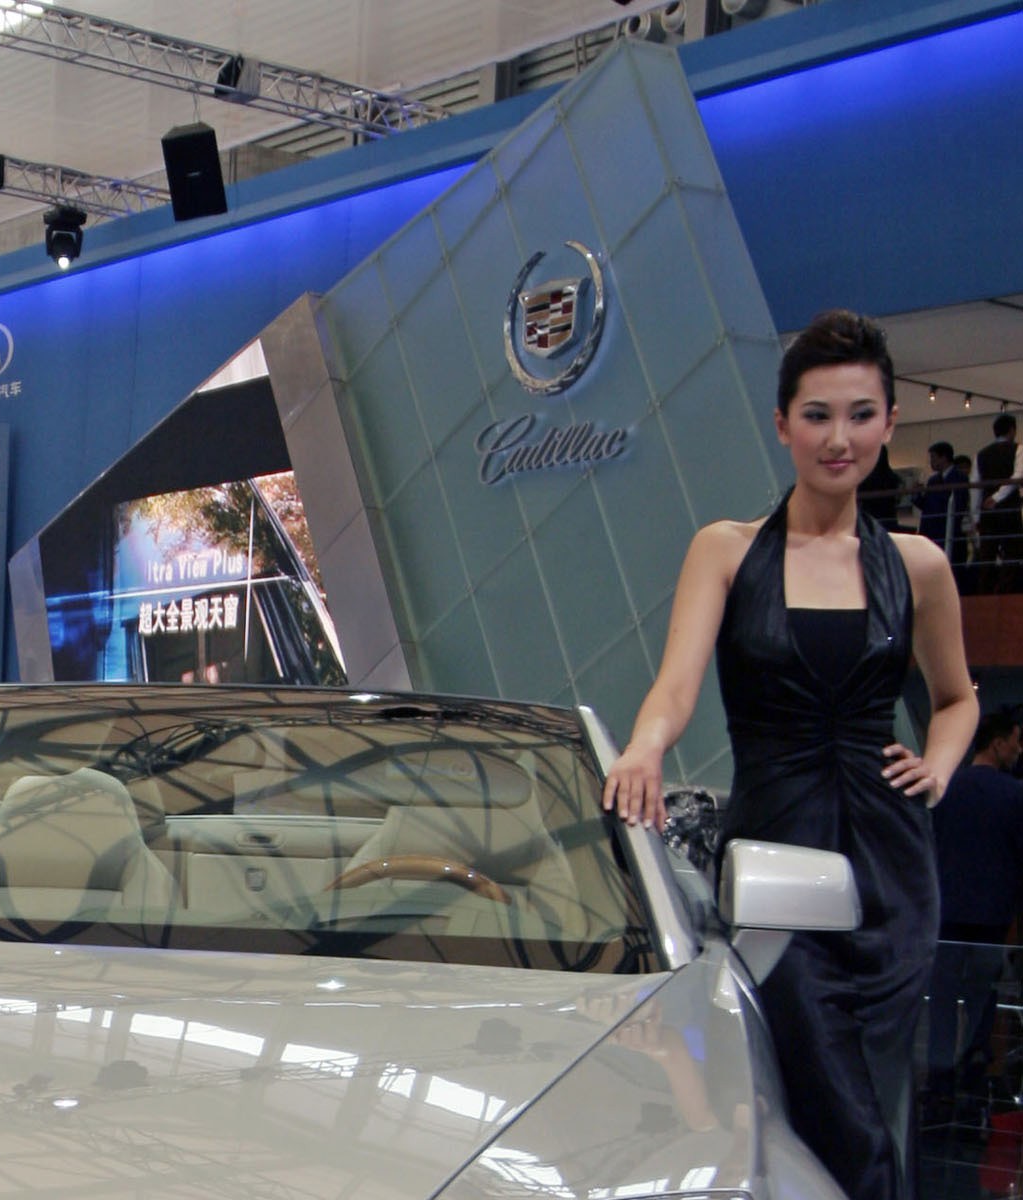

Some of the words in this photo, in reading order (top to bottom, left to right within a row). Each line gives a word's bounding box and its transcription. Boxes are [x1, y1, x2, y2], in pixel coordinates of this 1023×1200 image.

[474, 413, 628, 486] Cadillac
[141, 559, 173, 584] ltra
[212, 547, 244, 576] Plus
[138, 594, 238, 634] 超大全景观天窗
